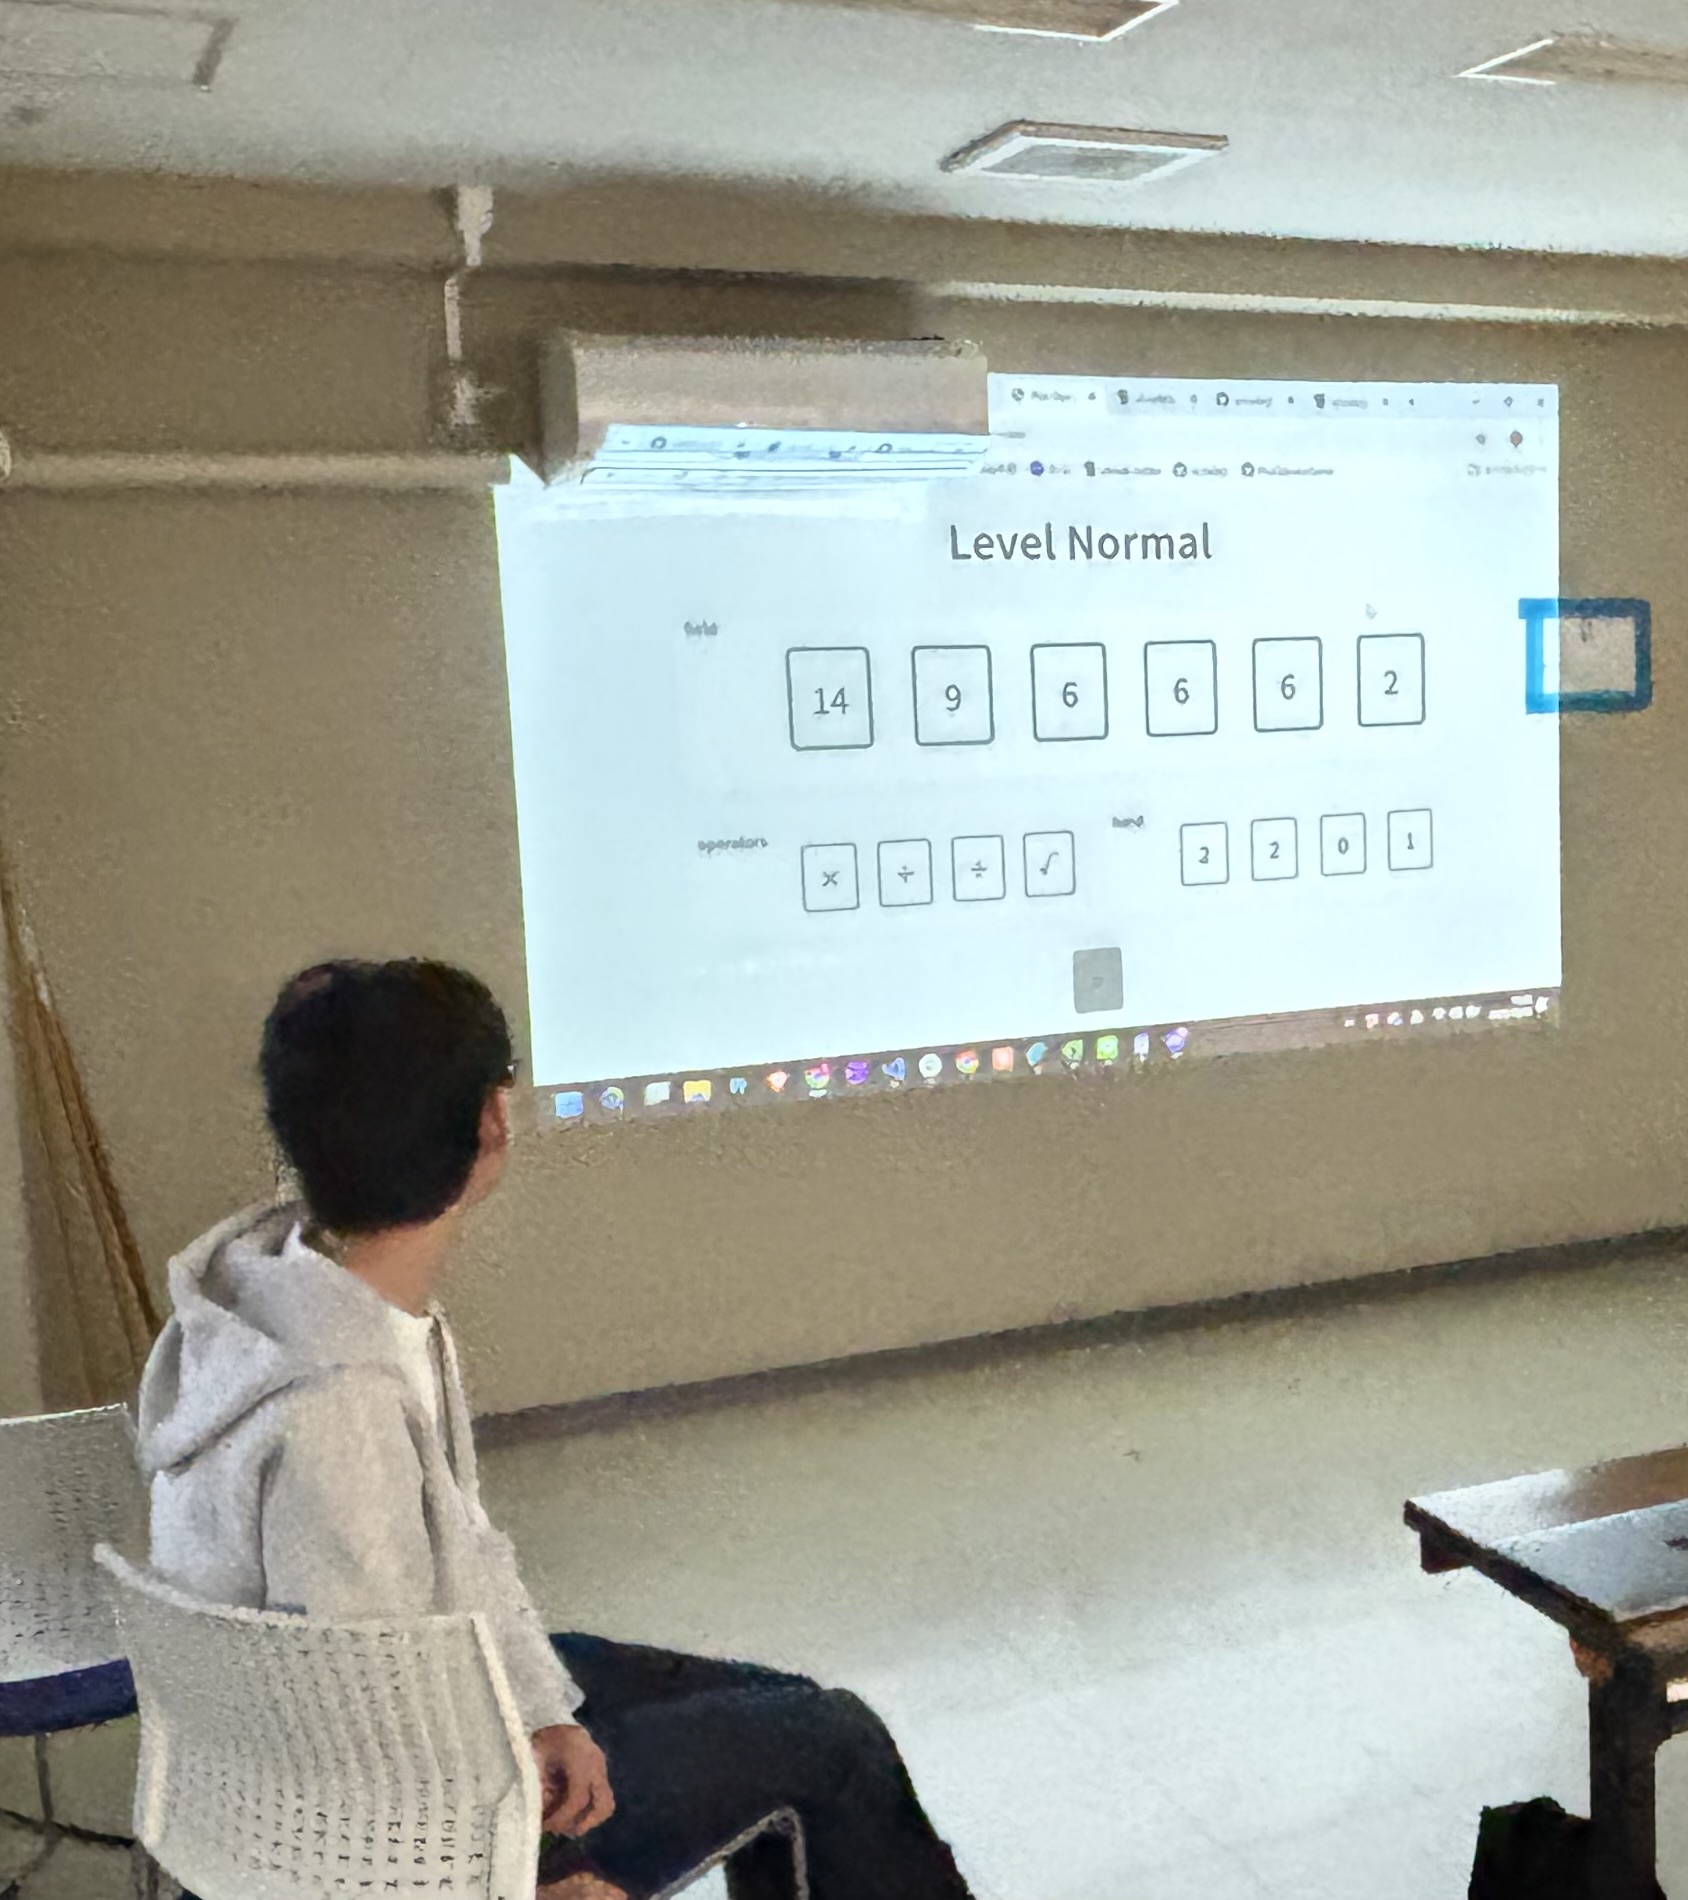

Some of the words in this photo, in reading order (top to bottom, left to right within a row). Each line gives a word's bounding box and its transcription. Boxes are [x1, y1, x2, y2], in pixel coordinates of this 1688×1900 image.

[949, 521, 1057, 561] Level
[1068, 521, 1213, 561] Normal
[812, 686, 851, 717] 14
[944, 684, 962, 712] 9
[1061, 681, 1080, 709] 6
[1172, 677, 1191, 706] 6
[1277, 672, 1297, 701] 6
[1383, 669, 1399, 696] 2
[1198, 844, 1210, 865] 2
[1268, 840, 1281, 860] 2
[1337, 836, 1350, 856] 0
[1406, 831, 1416, 851] 1
